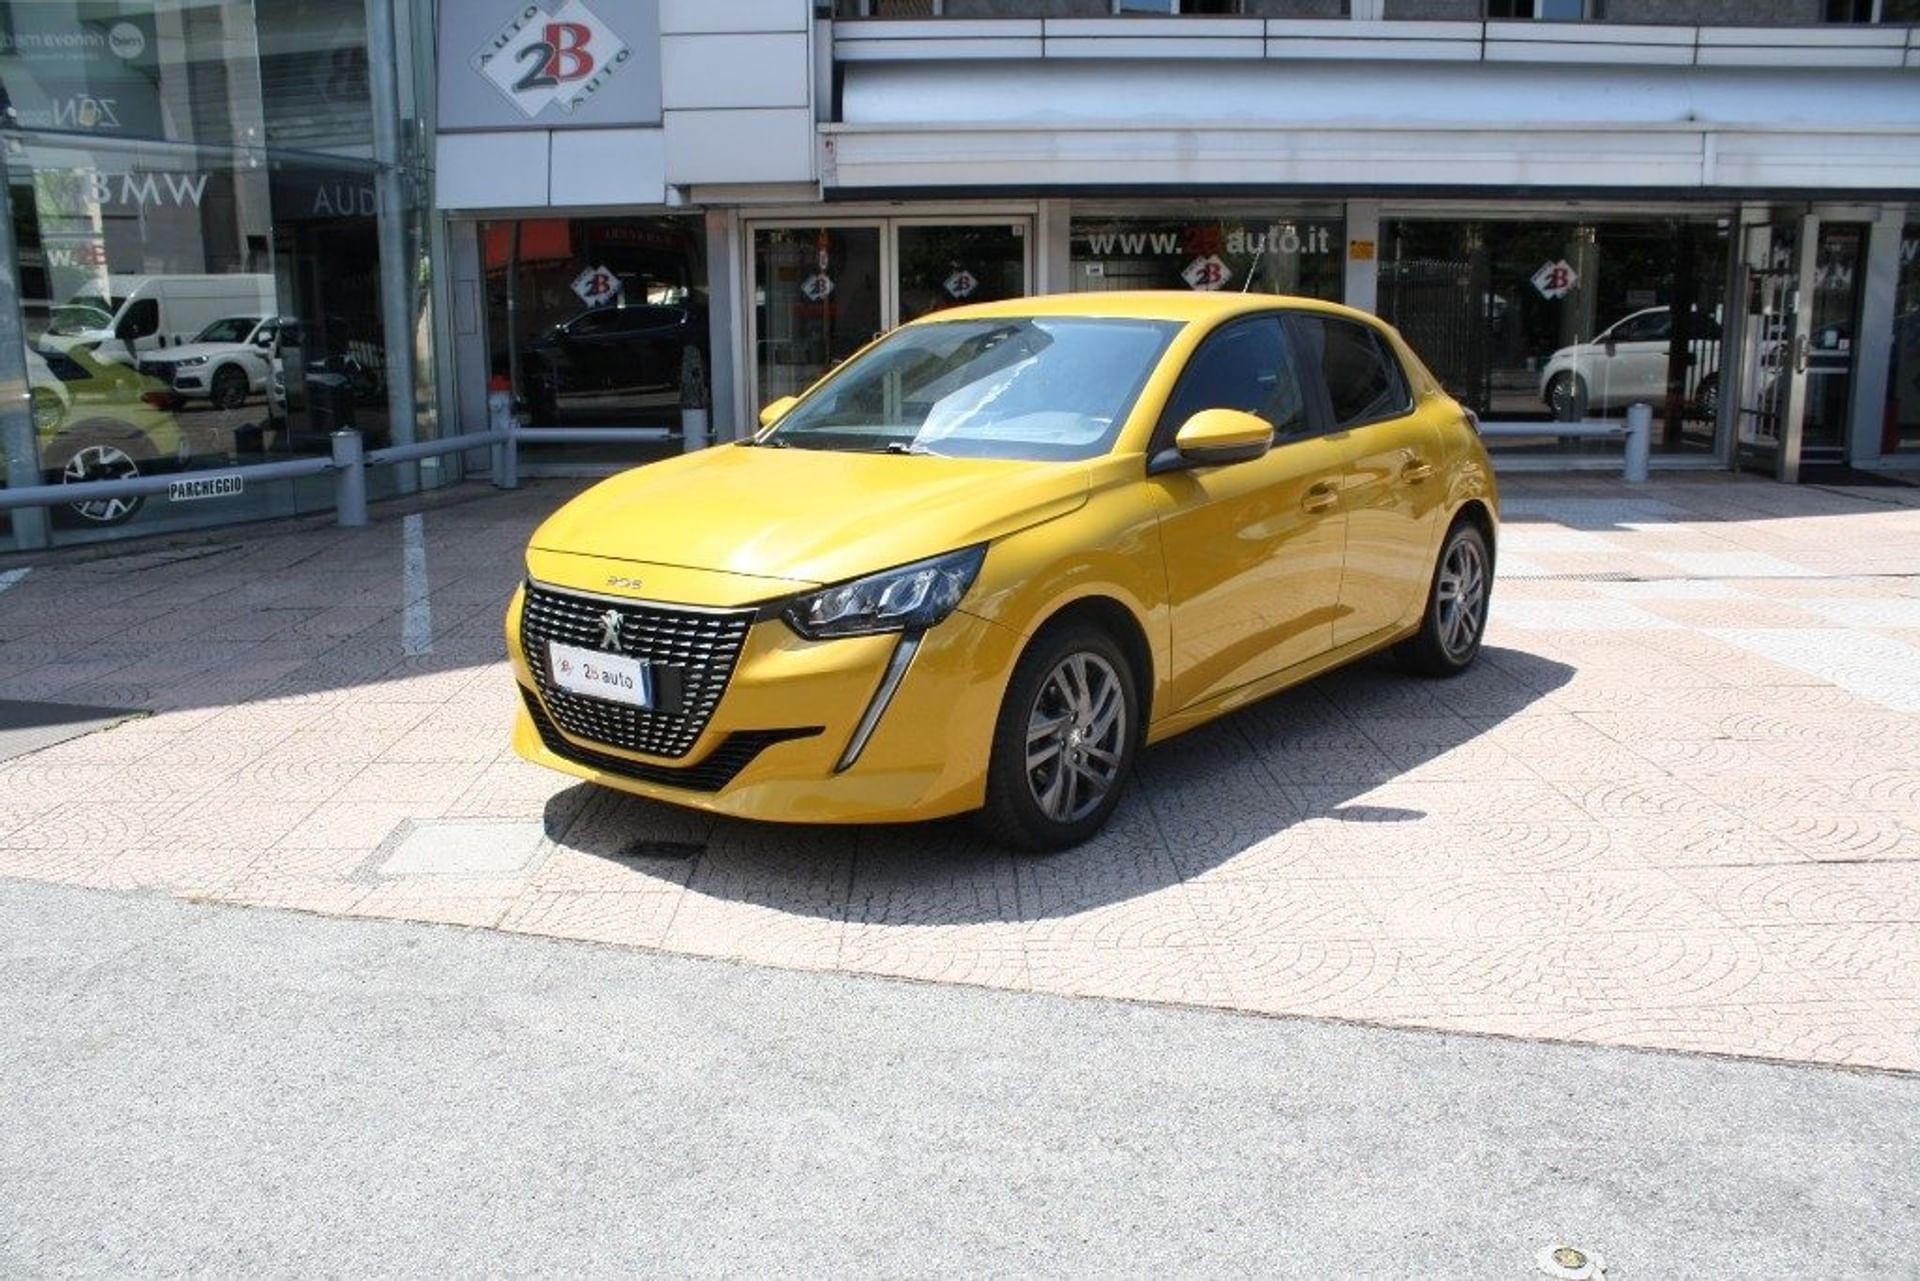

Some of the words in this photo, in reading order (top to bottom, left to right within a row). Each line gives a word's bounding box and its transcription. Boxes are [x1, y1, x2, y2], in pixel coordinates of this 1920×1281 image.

[479, 5, 538, 68] AUTO
[511, 22, 594, 93] 2B
[571, 49, 630, 109] AUTO
[1196, 262, 1221, 285] 2B
[1543, 268, 1568, 290] 2B
[170, 477, 242, 499] PARCHEGGIO
